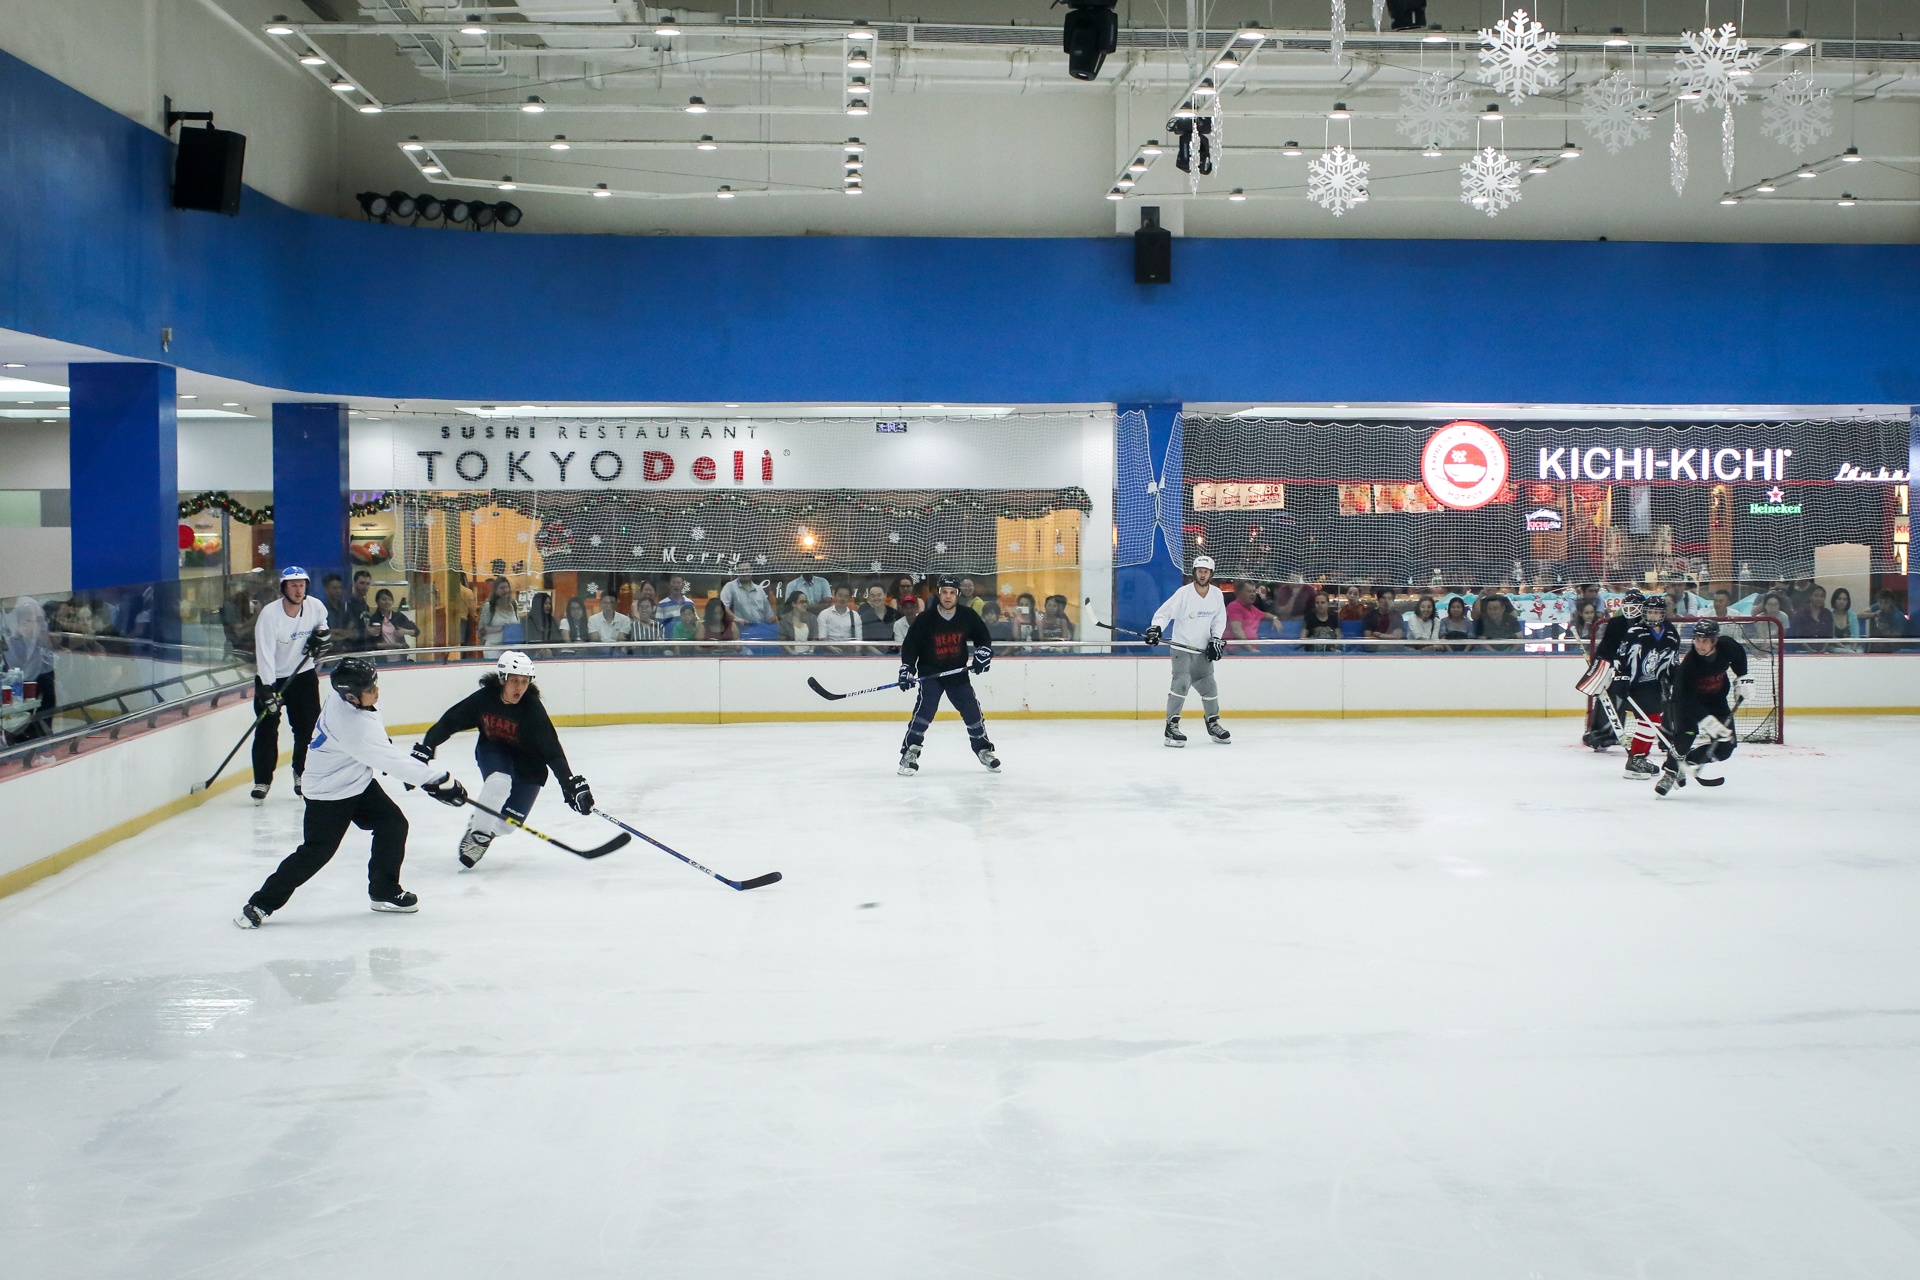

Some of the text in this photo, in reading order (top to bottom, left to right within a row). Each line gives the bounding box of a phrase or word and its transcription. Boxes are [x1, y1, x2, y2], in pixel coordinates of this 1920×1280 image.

[441, 426, 757, 439] SUSHI RESTAURANT
[416, 449, 773, 481] TOKYO Deli
[1539, 448, 1784, 480] KICHI-KICHI
[1750, 503, 1802, 514] Heineken
[662, 546, 742, 565] Merry
[935, 634, 963, 645] HEART
